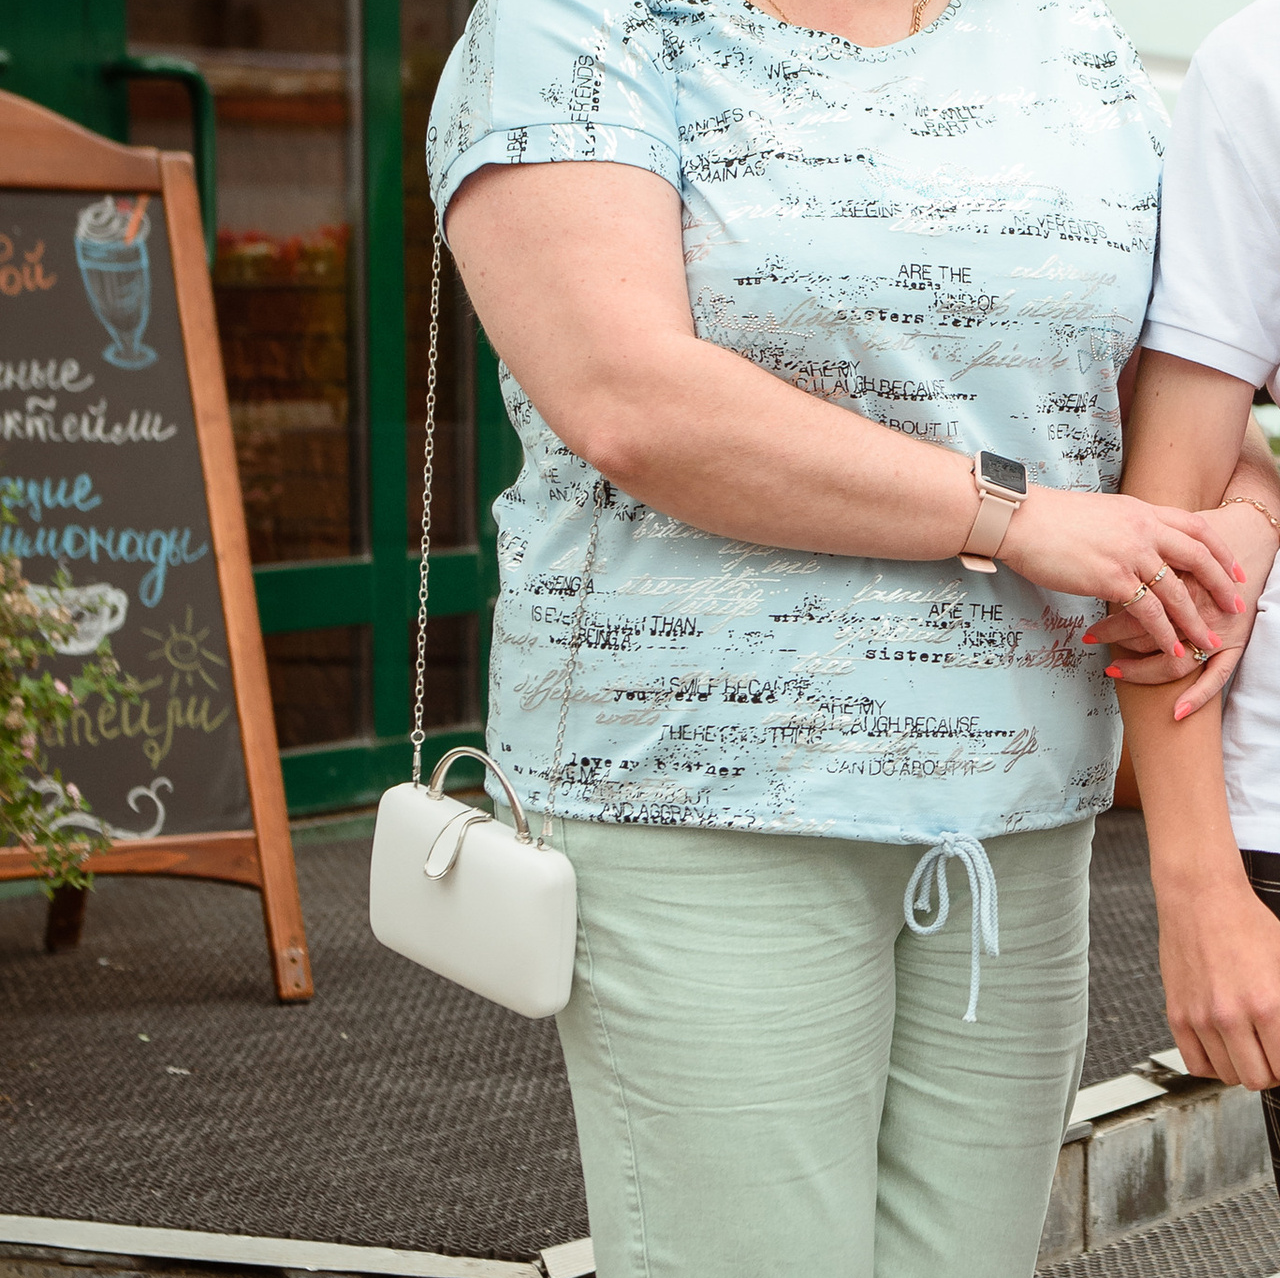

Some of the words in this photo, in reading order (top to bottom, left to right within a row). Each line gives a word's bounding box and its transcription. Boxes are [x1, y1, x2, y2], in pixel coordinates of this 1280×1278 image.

[898, 263, 932, 281] ARE
[938, 265, 972, 284] THE
[946, 420, 960, 437] IT
[928, 602, 965, 619] ARE
[970, 603, 1004, 621] THE
[865, 646, 954, 664] sisters
[905, 715, 981, 734] BECAUSE
